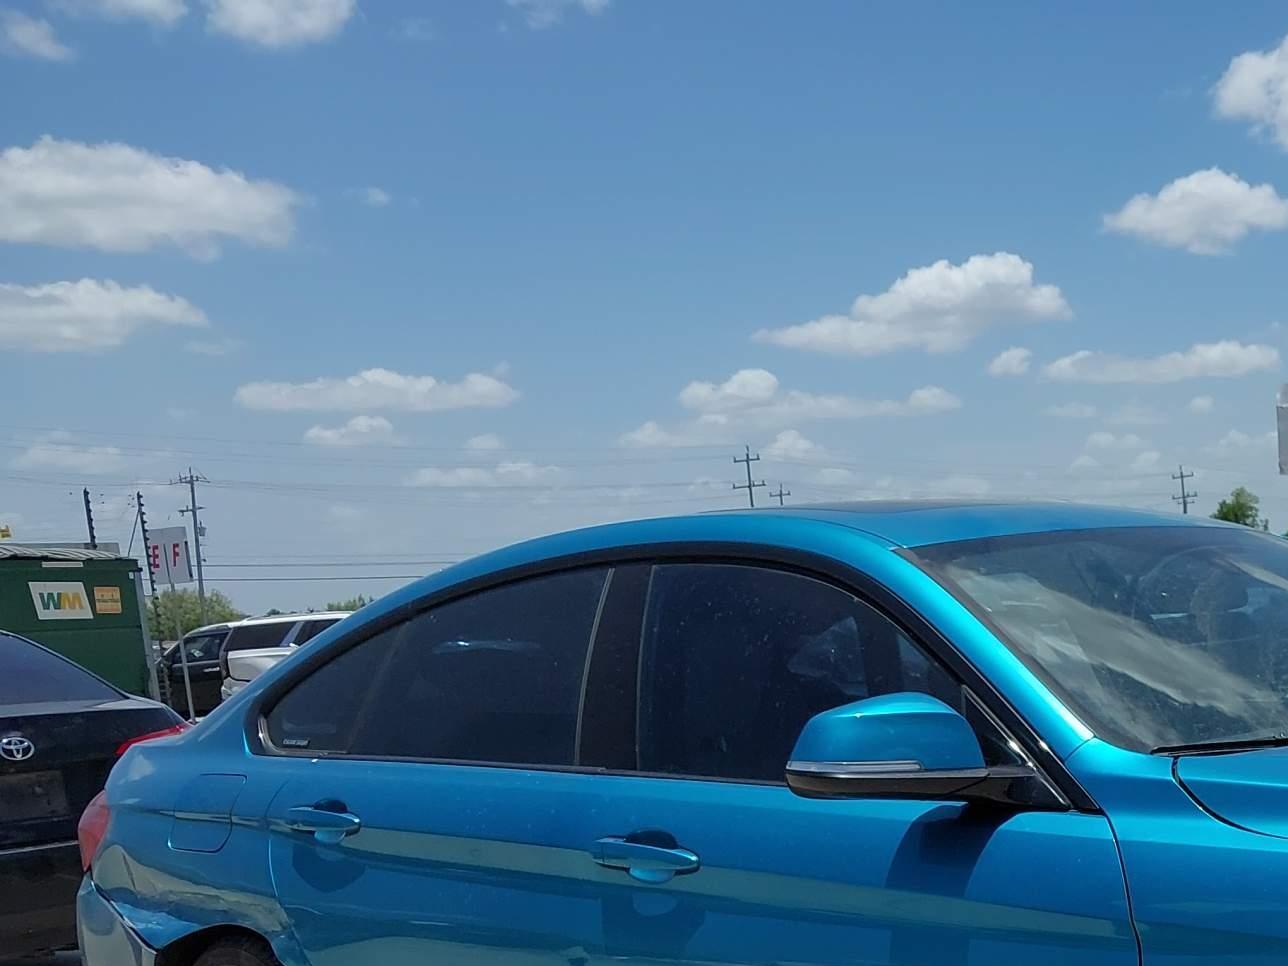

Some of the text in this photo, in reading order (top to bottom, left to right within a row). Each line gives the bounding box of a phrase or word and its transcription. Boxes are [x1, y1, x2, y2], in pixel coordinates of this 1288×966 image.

[152, 543, 180, 569] E F
[38, 592, 85, 610] WM
